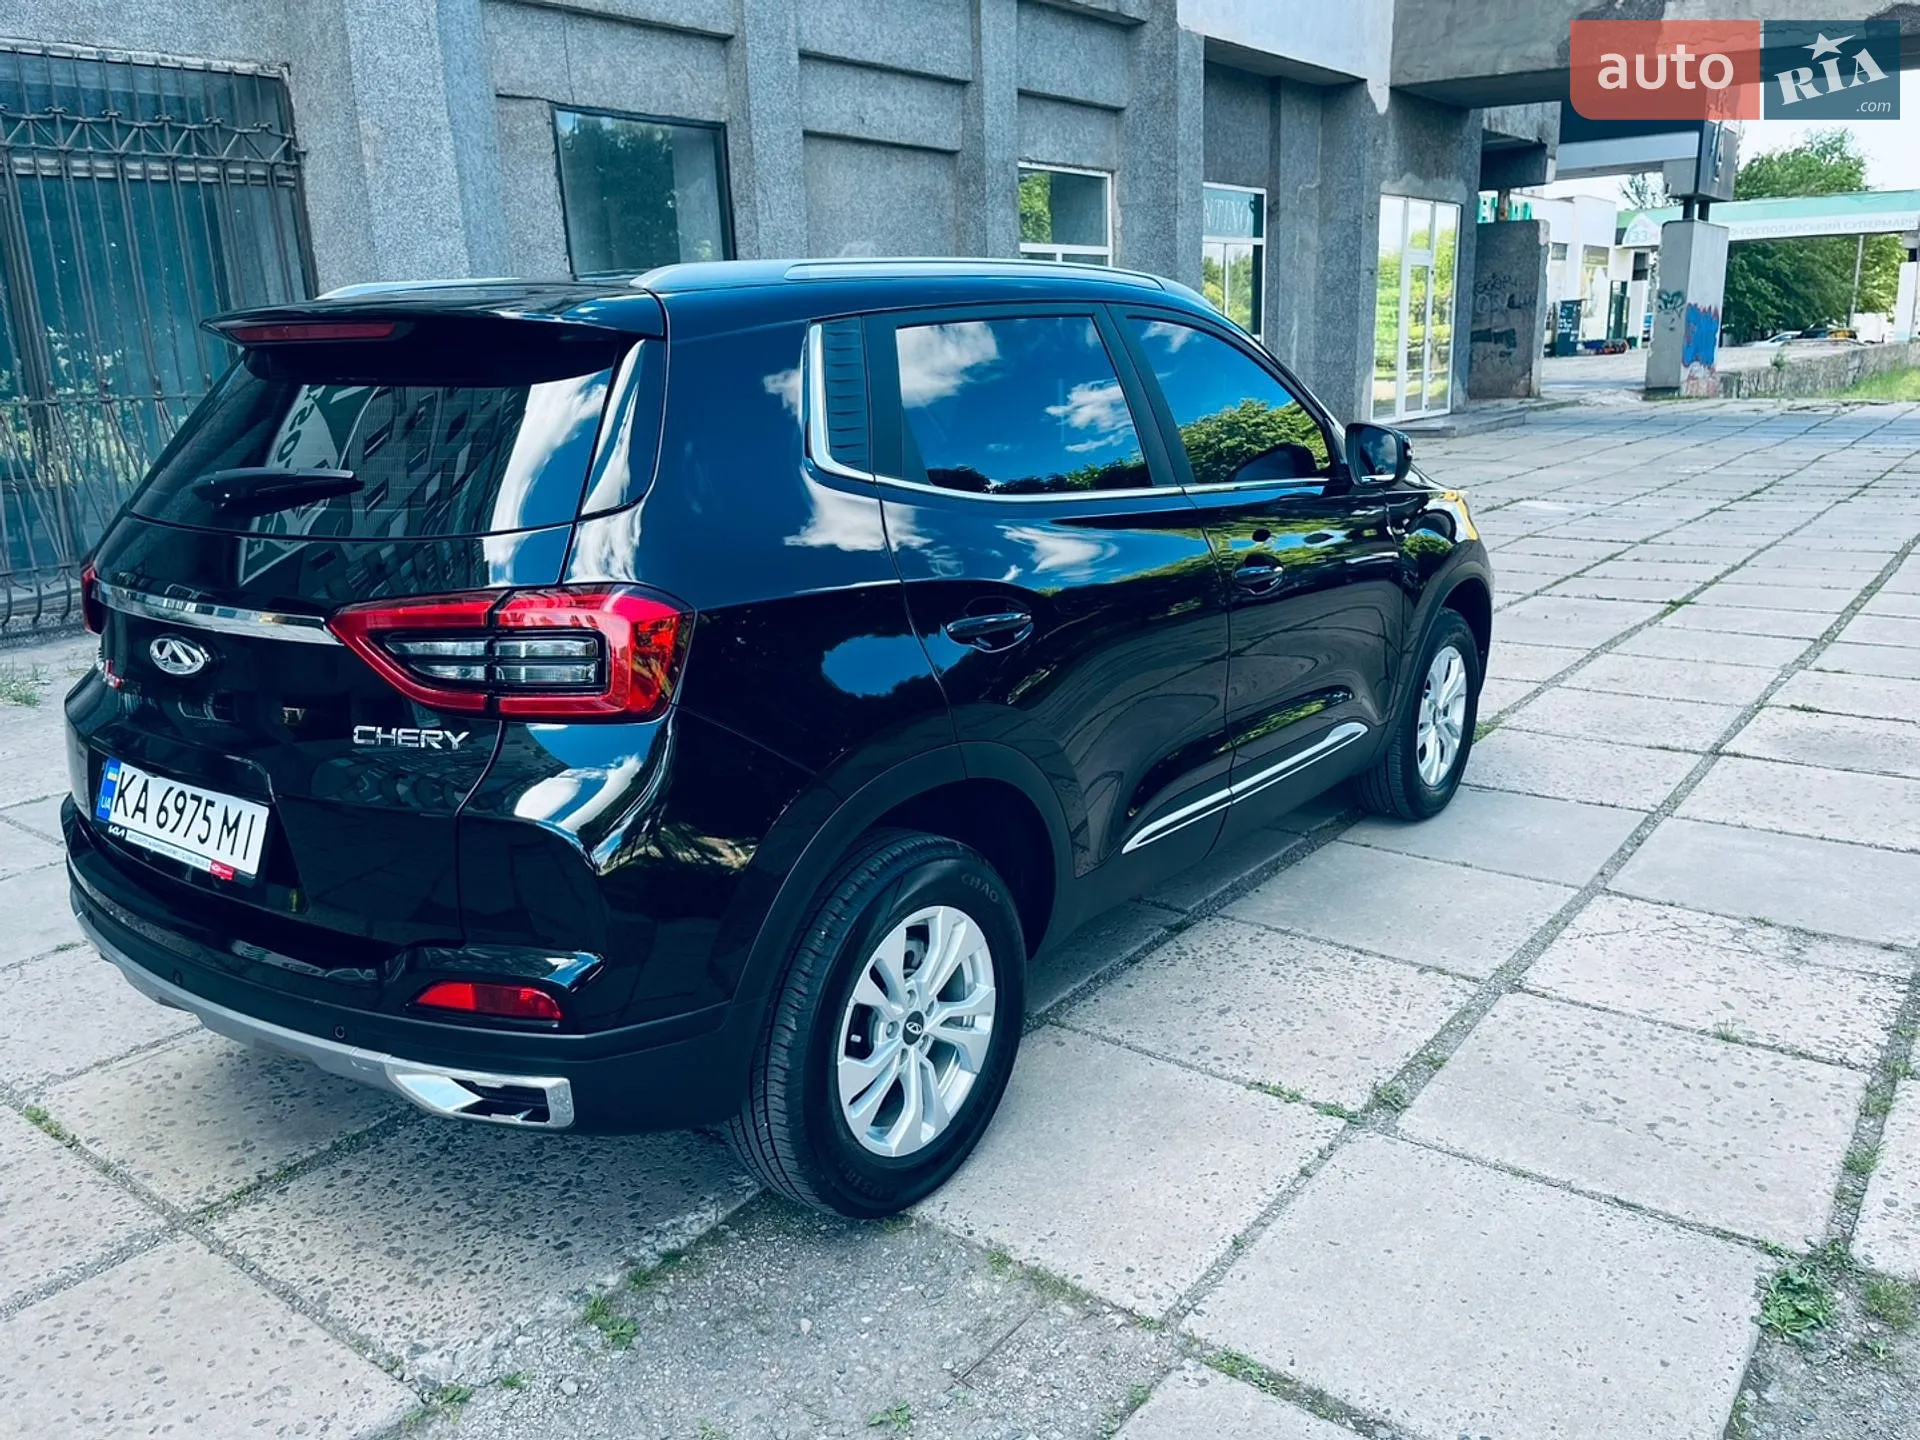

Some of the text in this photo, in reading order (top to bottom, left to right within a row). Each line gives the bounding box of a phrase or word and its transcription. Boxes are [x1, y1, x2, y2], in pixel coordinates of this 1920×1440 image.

[353, 725, 469, 750] CHERY
[113, 771, 151, 824] KA
[156, 786, 215, 845] 6975
[217, 804, 255, 861] MI
